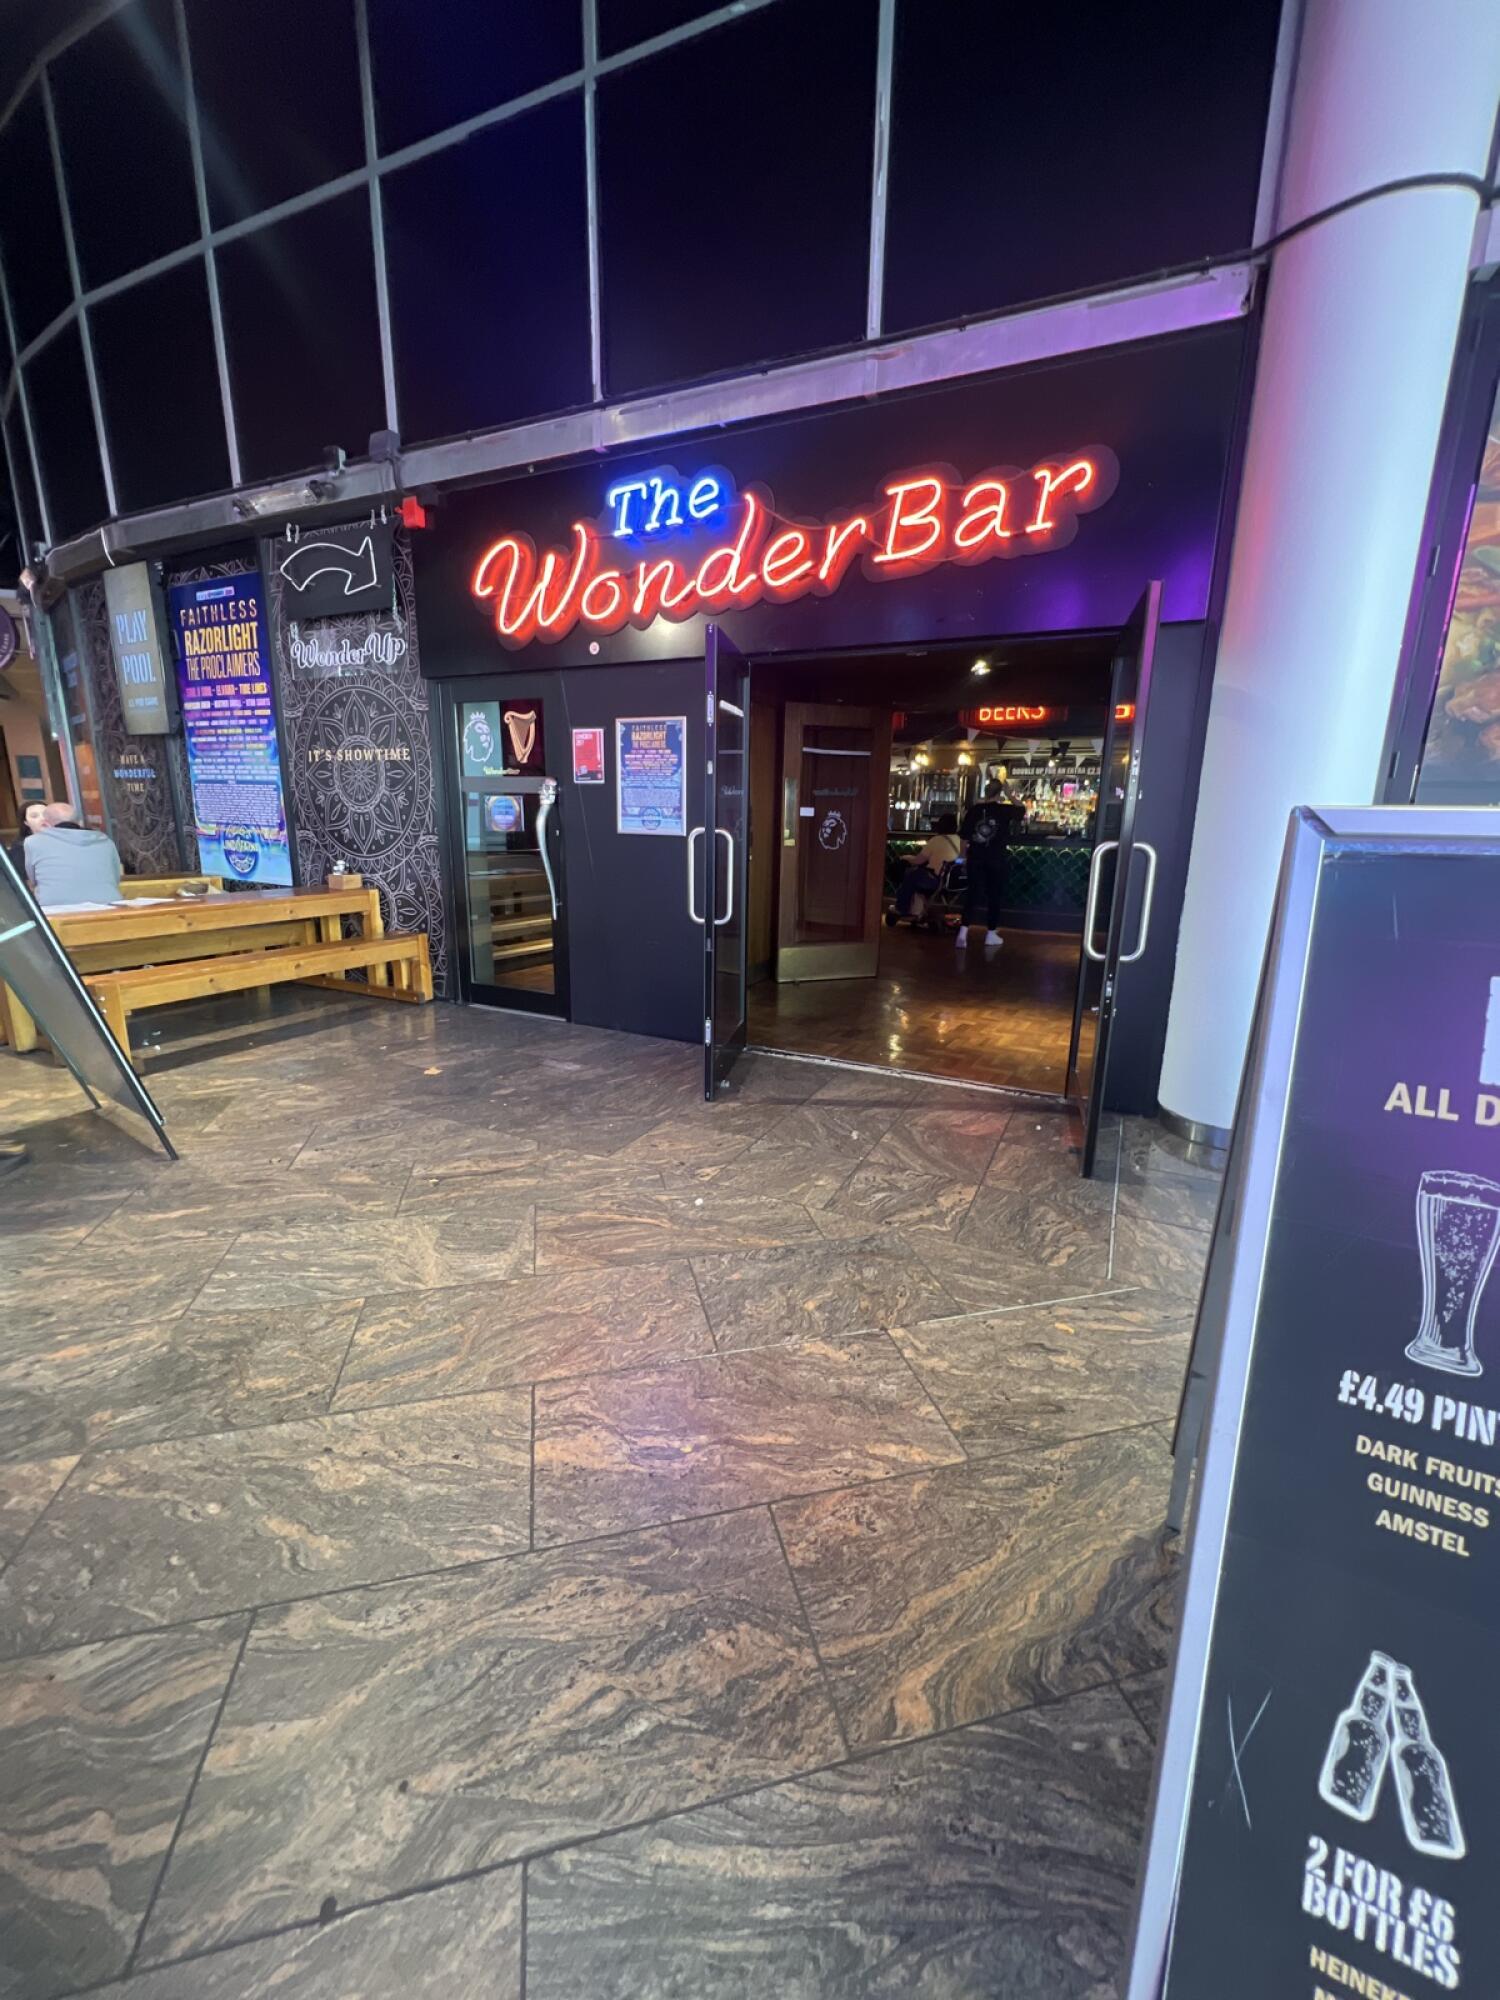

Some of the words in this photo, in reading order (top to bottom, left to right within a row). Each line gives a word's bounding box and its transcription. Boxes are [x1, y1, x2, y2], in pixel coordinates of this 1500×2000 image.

[607, 472, 720, 538] The
[115, 609, 148, 645] PLAY
[180, 599, 257, 626] FAITHLESS
[184, 622, 258, 656] RAZORLIGHT
[122, 652, 157, 685] POOL
[185, 657, 200, 680] THE
[201, 651, 261, 680] PROCLAIMERS
[308, 749, 332, 763] IT'S
[336, 748, 411, 761] SHOWTIME
[1036, 767, 1045, 776] UP
[127, 782, 145, 793] TIME
[1383, 1081, 1460, 1122] ALL
[1338, 1369, 1425, 1424] £4.49
[1431, 1394, 1500, 1446] PIN
[1355, 1434, 1419, 1471] DARK
[1367, 1472, 1490, 1528] GUINNESS
[1375, 1509, 1470, 1557] AMSTEL
[1305, 1835, 1328, 1881] 2
[1333, 1847, 1403, 1917] FOR
[1408, 1887, 1456, 1943] £6
[1302, 1870, 1461, 1990] BOTTLES
[1309, 1944, 1413, 2000] HEINEK
